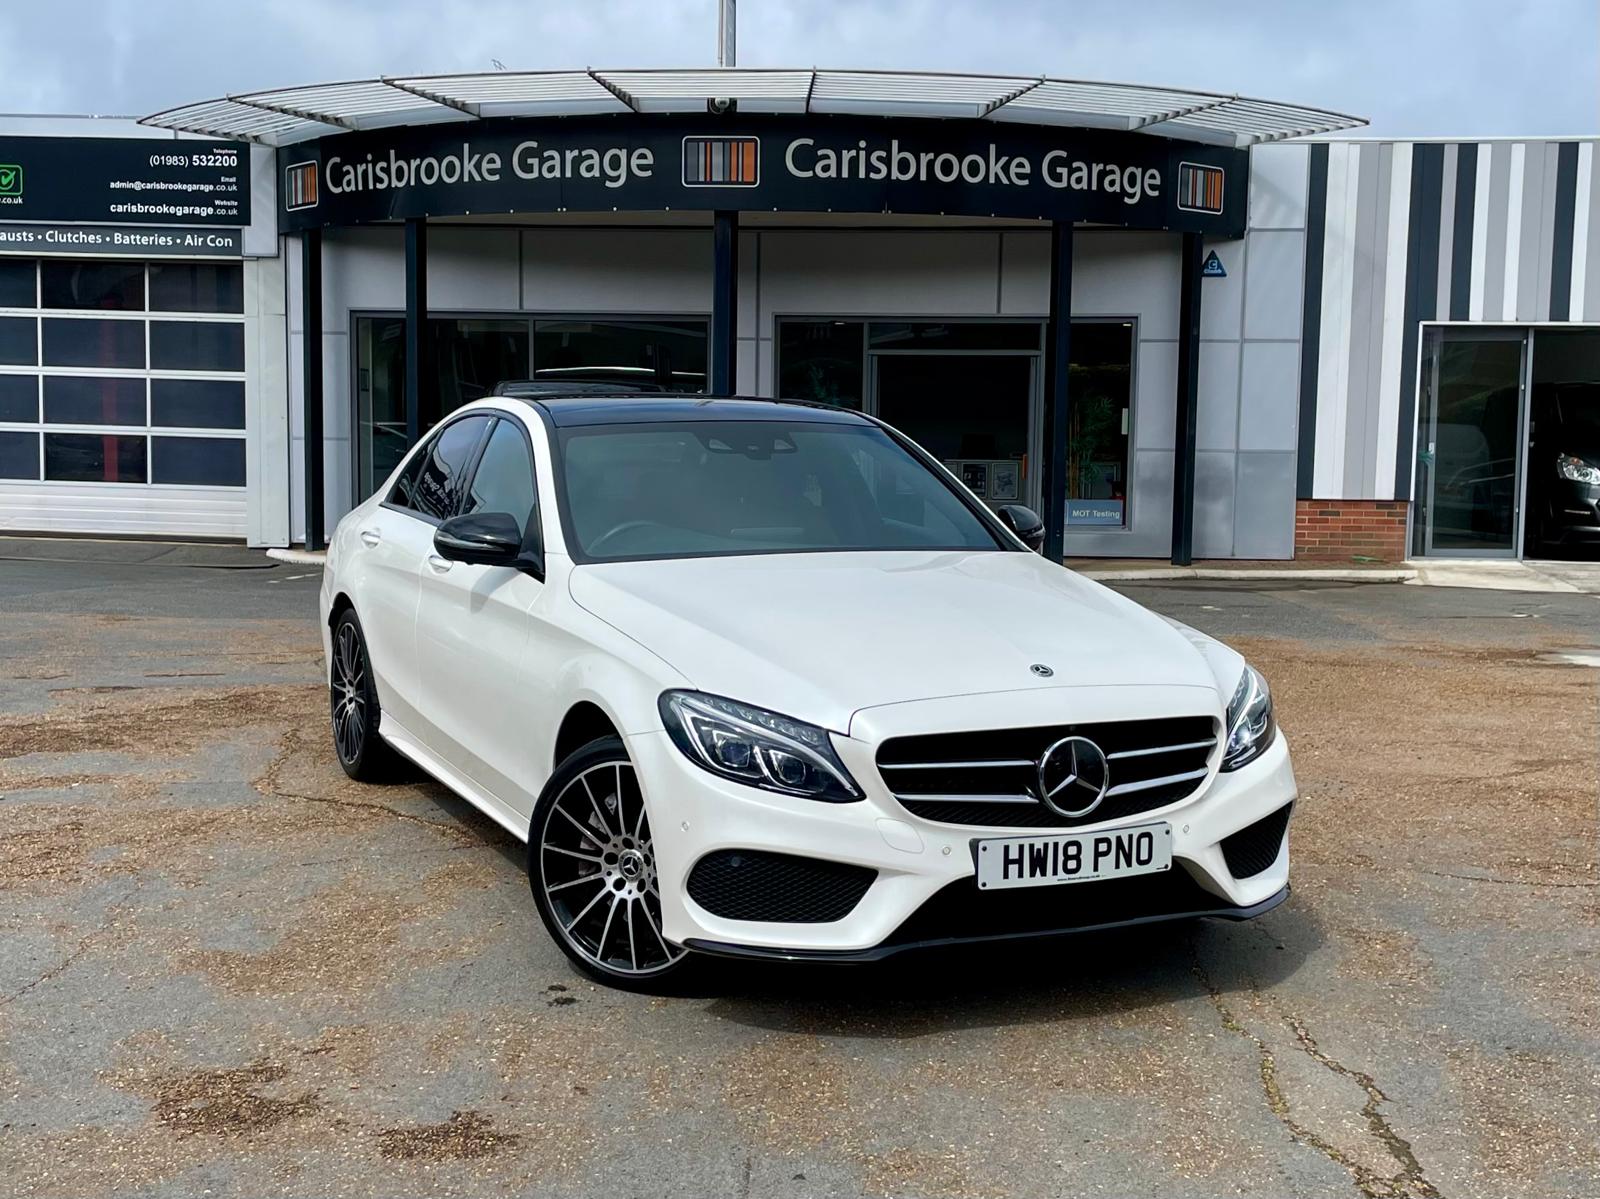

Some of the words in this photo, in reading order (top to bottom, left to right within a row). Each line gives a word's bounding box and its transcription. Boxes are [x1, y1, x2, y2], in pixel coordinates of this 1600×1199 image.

[149, 155, 189, 168] (01983)
[192, 155, 238, 167] 532200
[325, 143, 501, 194] Carisbrooke
[511, 141, 654, 188] Garage
[785, 138, 1031, 186] Carisbrooke
[1041, 150, 1161, 205] Garage
[109, 180, 238, 193] admin@carisbrookegarage.co.uk
[0, 196, 23, 205] .co.uk
[109, 202, 238, 217] carisbrookegarage.co.uk
[45, 230, 102, 244] Clutches
[113, 232, 173, 246] Batteries
[184, 234, 204, 247] Air
[206, 235, 233, 247] Con
[1072, 510, 1090, 518] MOT
[1092, 510, 1120, 520] Testing
[1002, 840, 1082, 880] HW18
[1092, 831, 1154, 873] PNO
